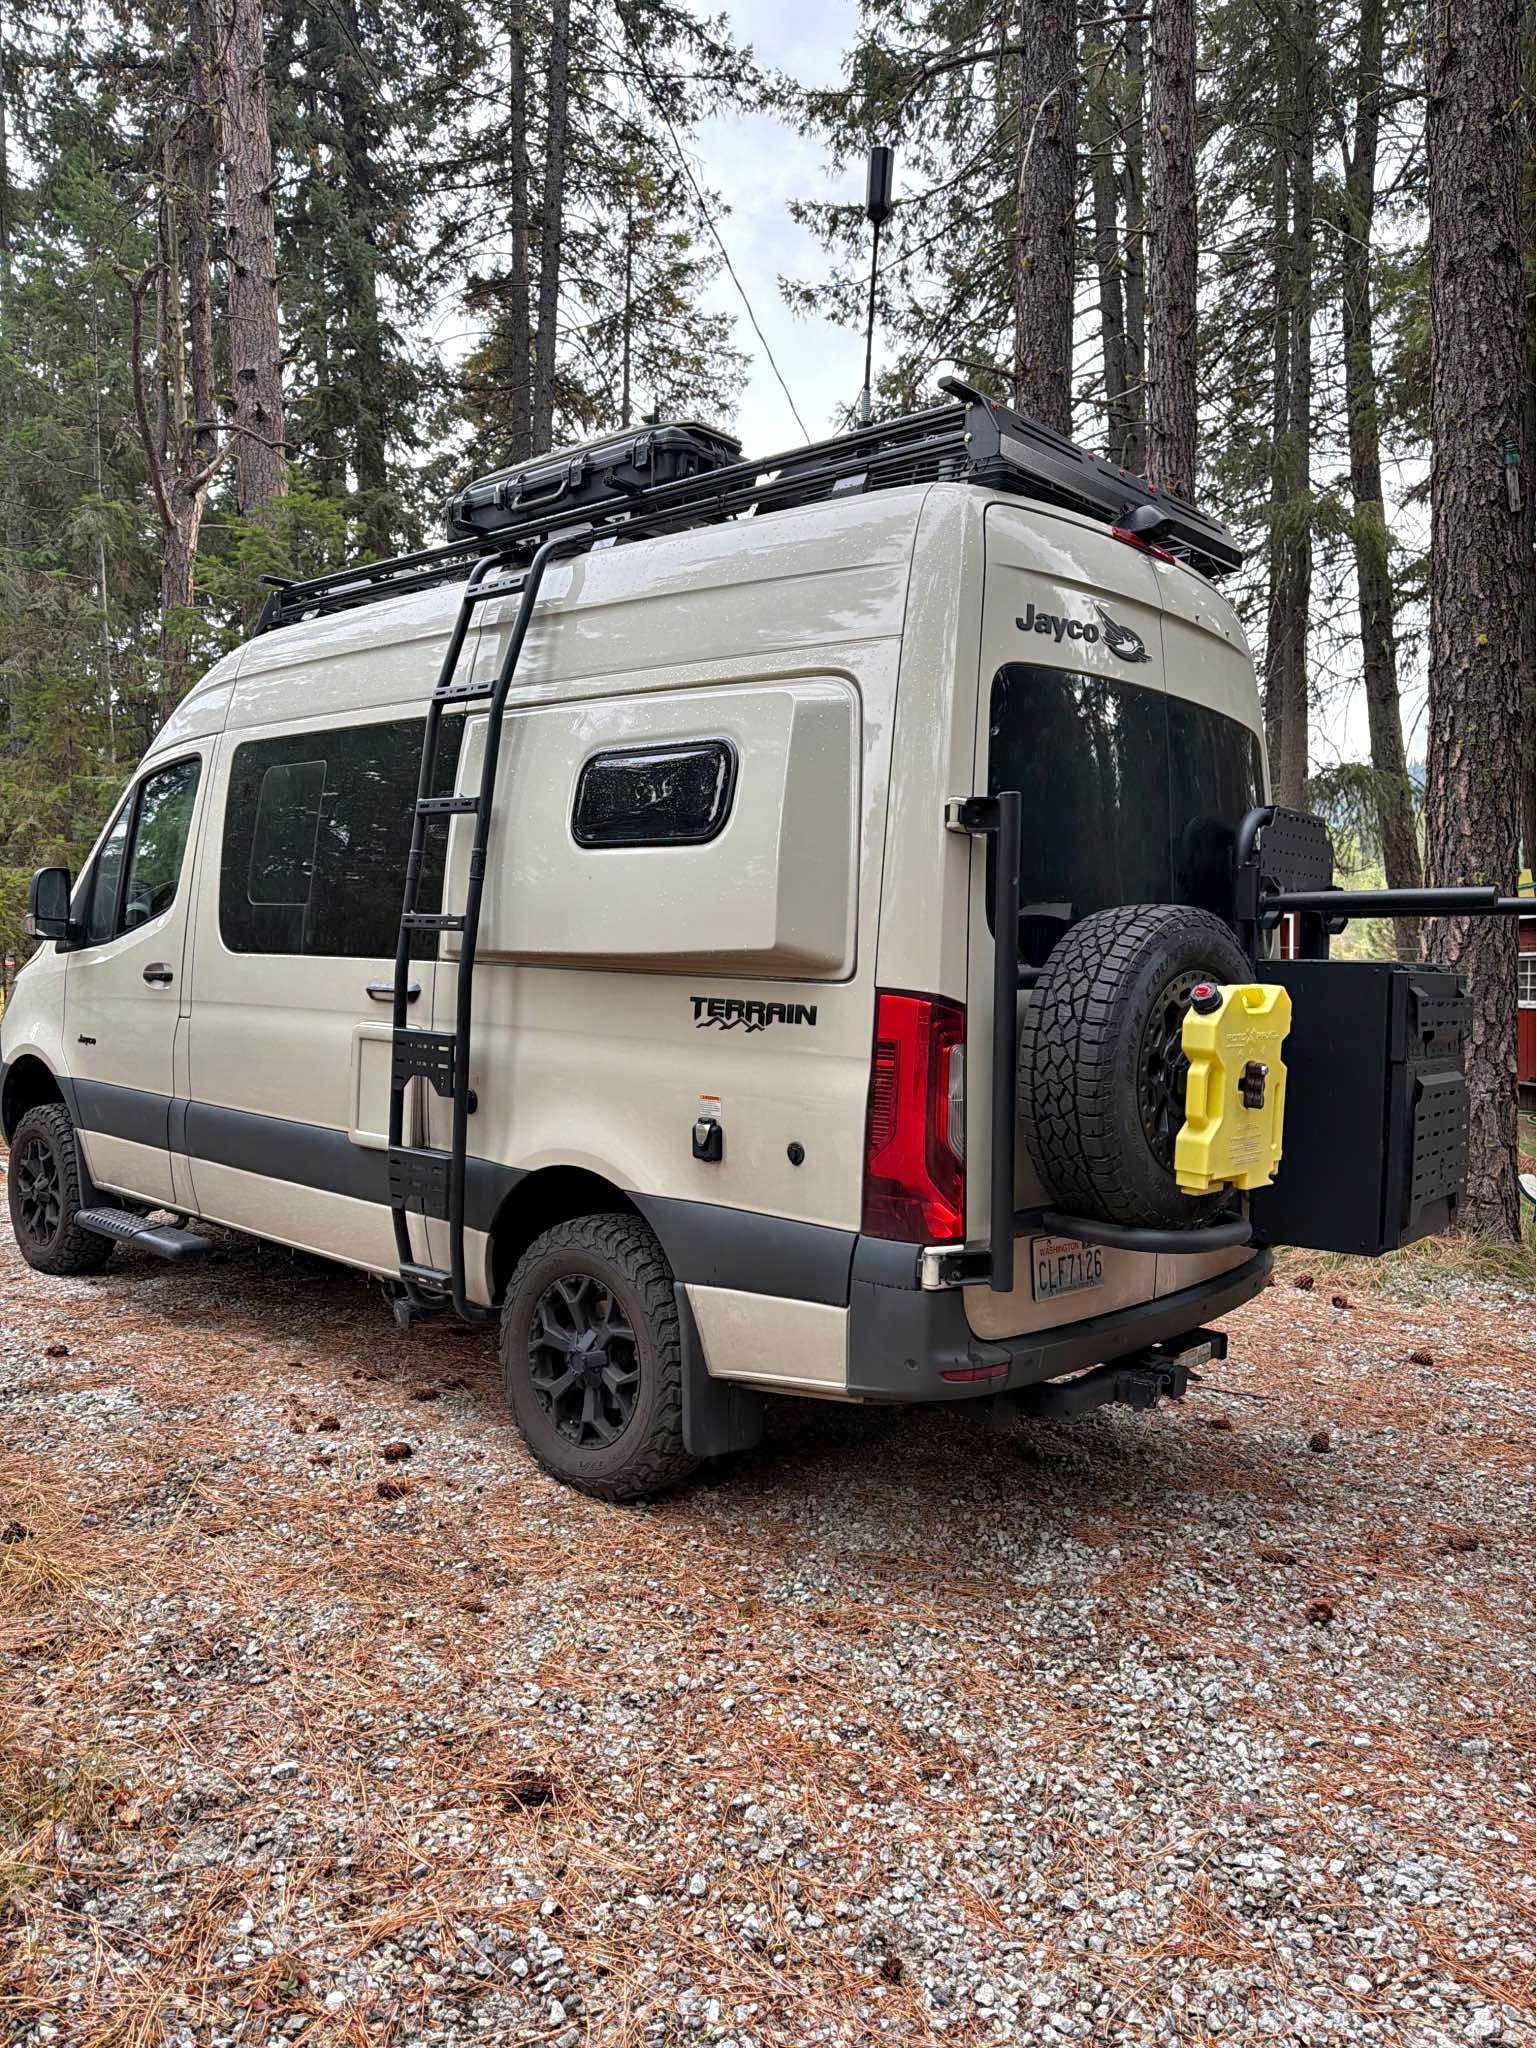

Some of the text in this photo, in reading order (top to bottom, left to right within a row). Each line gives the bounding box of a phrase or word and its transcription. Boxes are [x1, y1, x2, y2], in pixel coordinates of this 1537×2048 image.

[1015, 603, 1100, 643] Jayco
[690, 996, 818, 1026] TERRAIN
[1039, 1241, 1080, 1257] WASHINGTON
[1038, 1248, 1102, 1291] CLF7126
